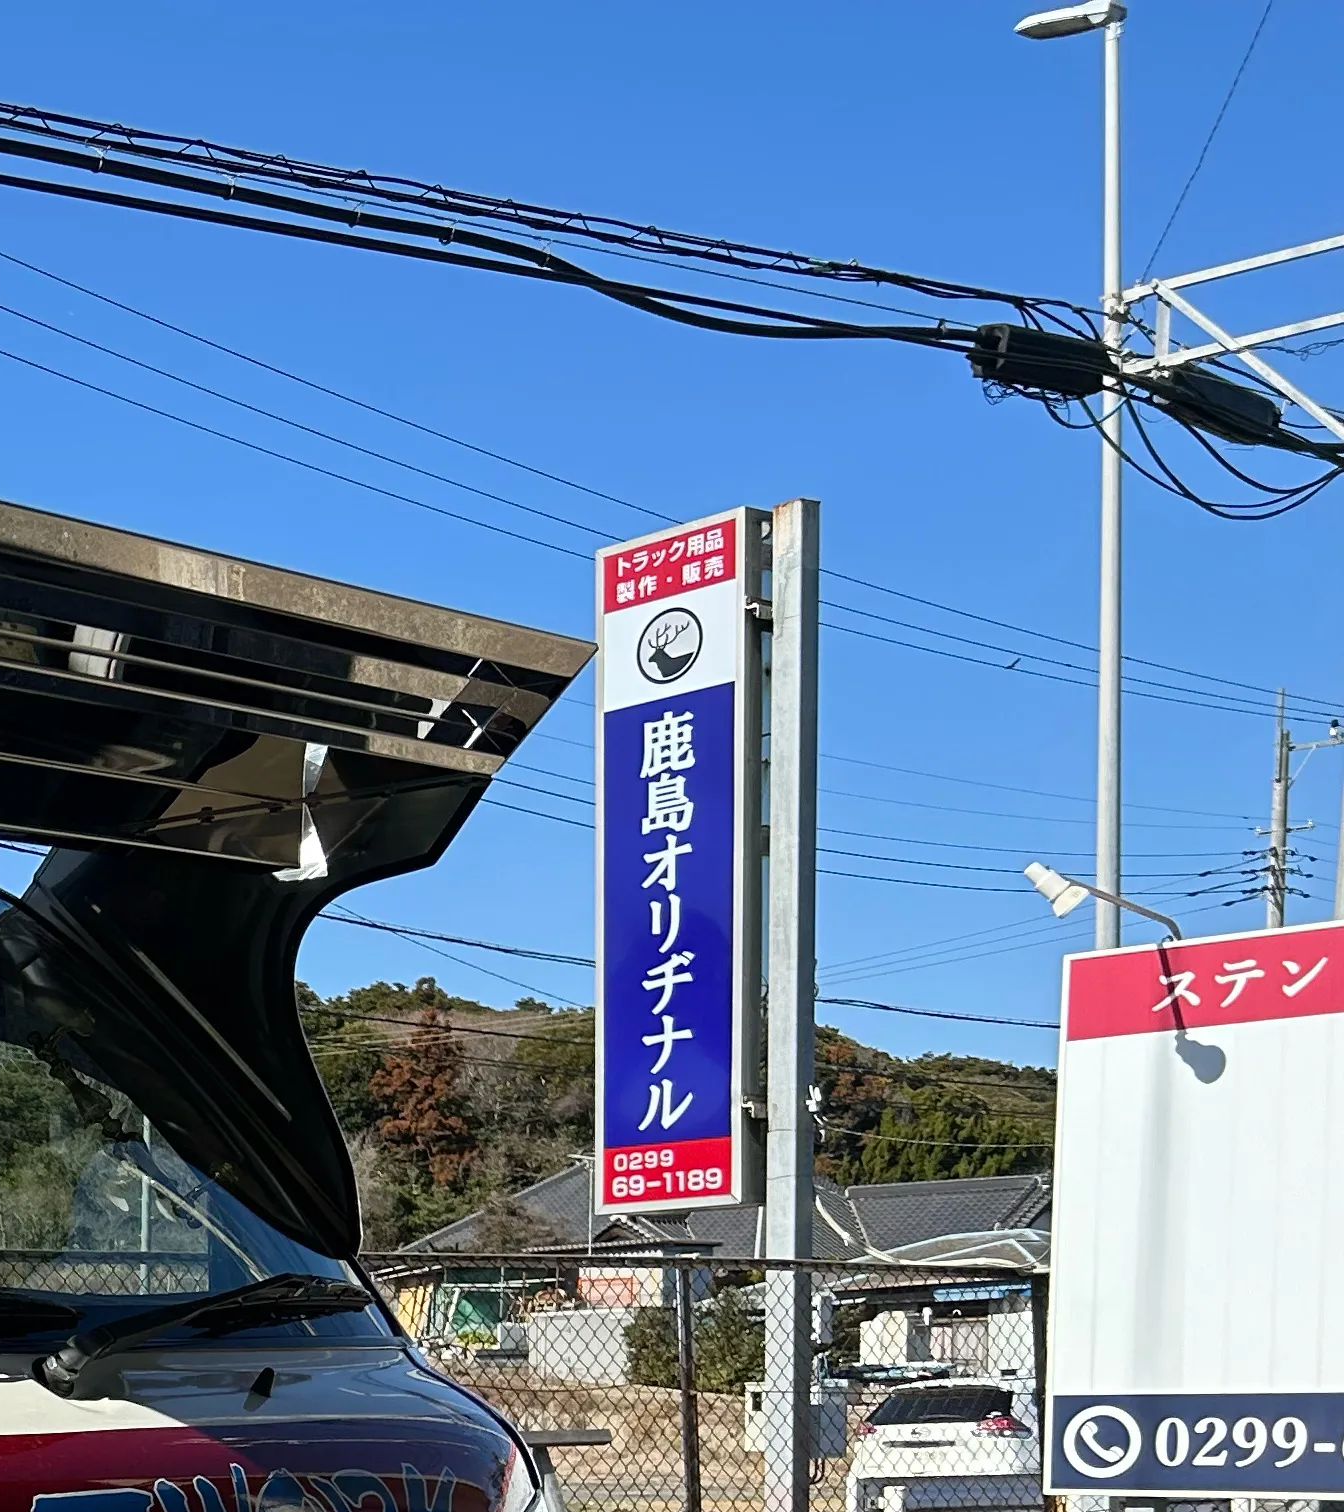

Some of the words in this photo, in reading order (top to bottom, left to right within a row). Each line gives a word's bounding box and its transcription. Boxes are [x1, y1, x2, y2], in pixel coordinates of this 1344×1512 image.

[616, 528, 725, 577] トラック用品
[615, 555, 726, 604] 製作・販売
[638, 710, 697, 1134] 鹿島オリヂナル
[1150, 955, 1330, 1014] ステン
[611, 1166, 724, 1198] 69-1189
[613, 1149, 675, 1171] 0299
[1154, 1413, 1344, 1470] 0299-
